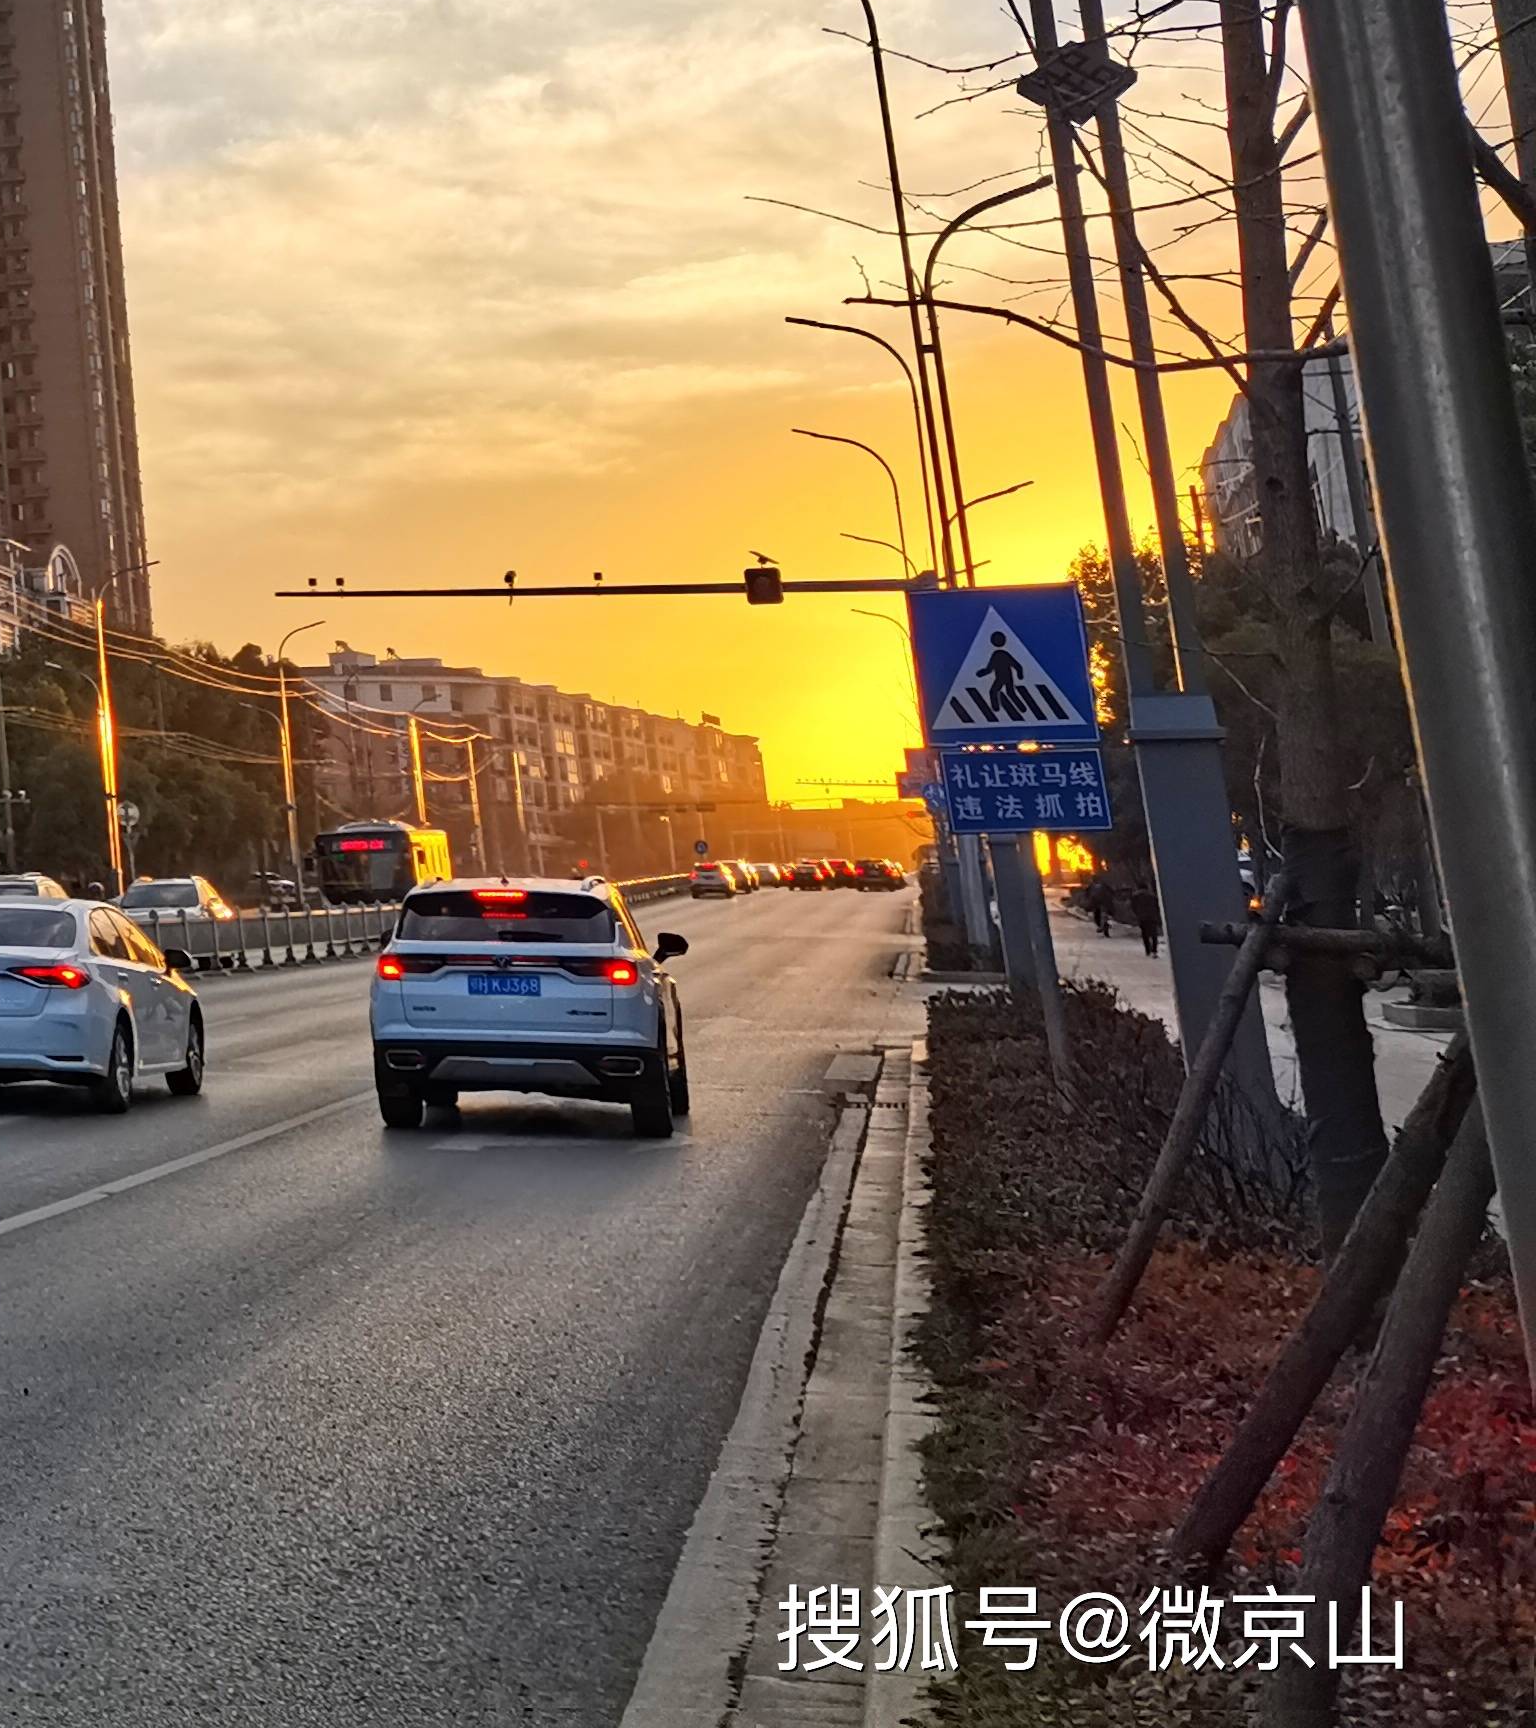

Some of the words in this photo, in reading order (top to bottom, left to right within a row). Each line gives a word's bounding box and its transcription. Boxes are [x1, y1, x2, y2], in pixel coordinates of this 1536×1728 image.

[950, 761, 1099, 790] 礼让斑马线
[955, 791, 1104, 821] 违法抓拍
